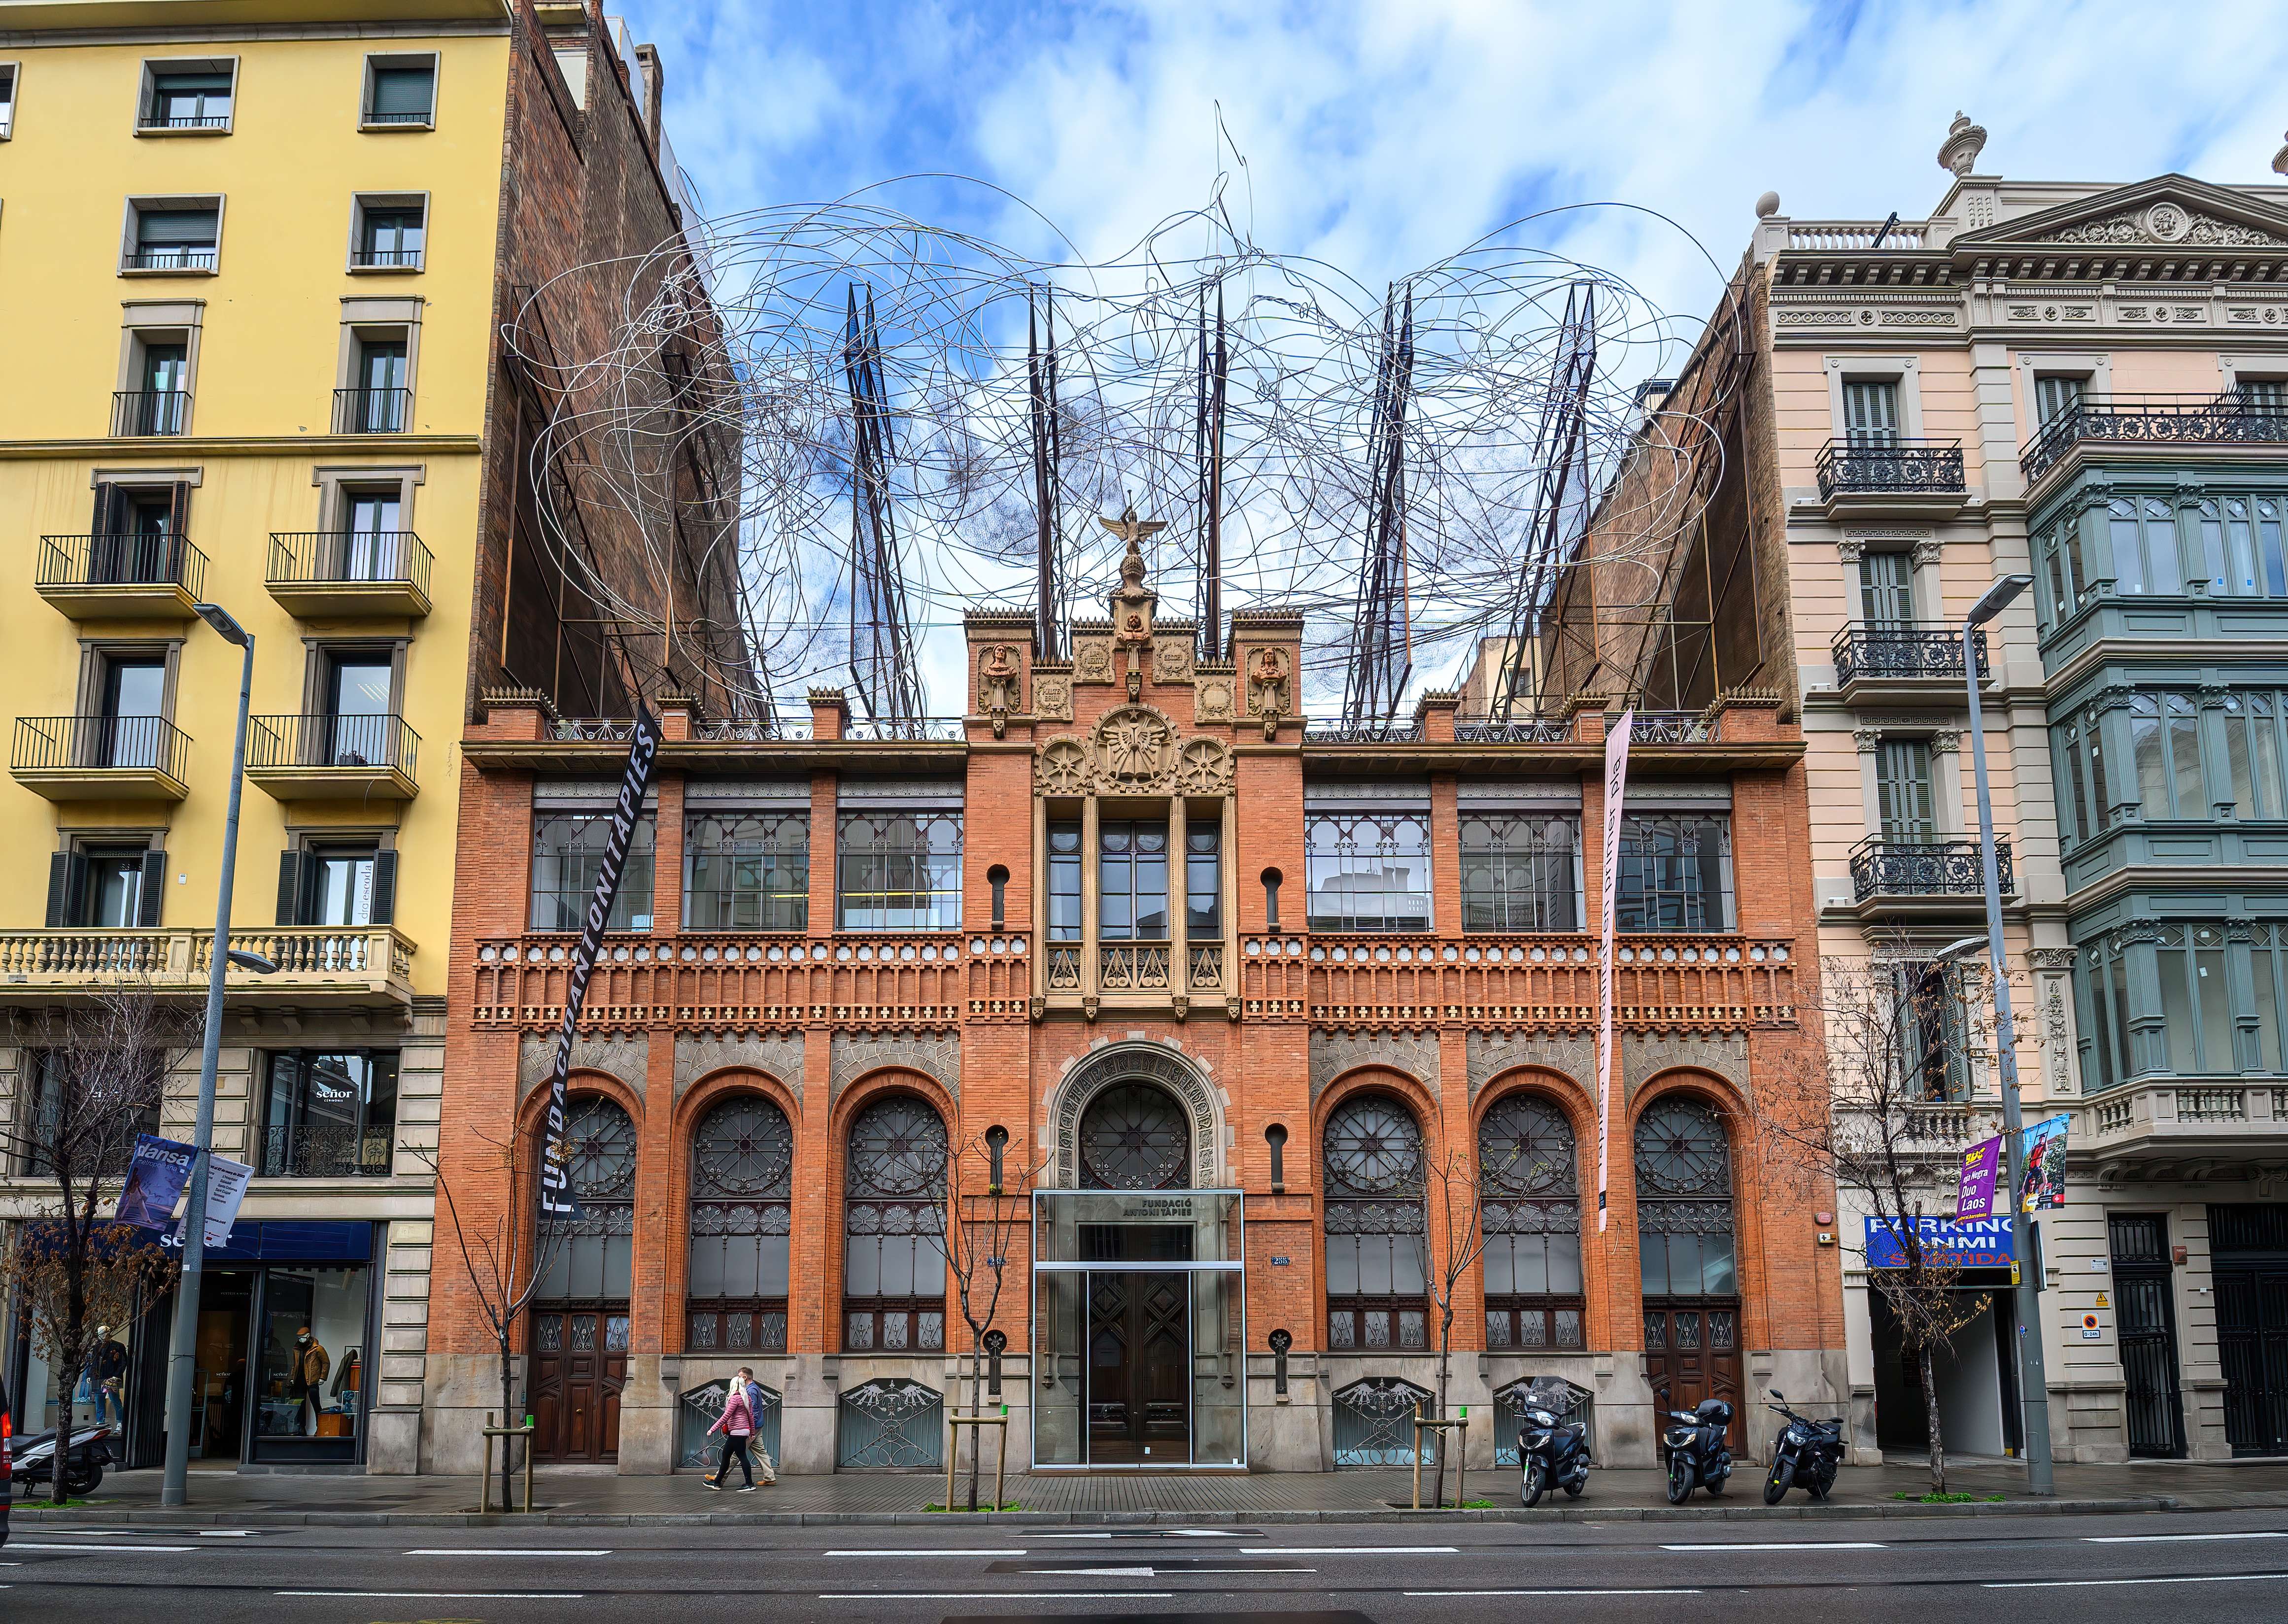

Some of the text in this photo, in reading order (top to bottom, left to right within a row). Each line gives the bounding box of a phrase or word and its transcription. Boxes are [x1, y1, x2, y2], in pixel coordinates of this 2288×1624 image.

[1609, 755, 1621, 798] pla
[1605, 808, 1616, 893] primer
[316, 1089, 353, 1098] señor
[137, 1143, 190, 1167] dansa
[137, 1159, 177, 1172] metropolitana
[1971, 1169, 1988, 1181] Negra
[1961, 1185, 1977, 1199] Duo
[1142, 1198, 1192, 1208] FUNDACIÓ
[1961, 1197, 1986, 1212] Laos
[1161, 1207, 1192, 1216] TÀPIES
